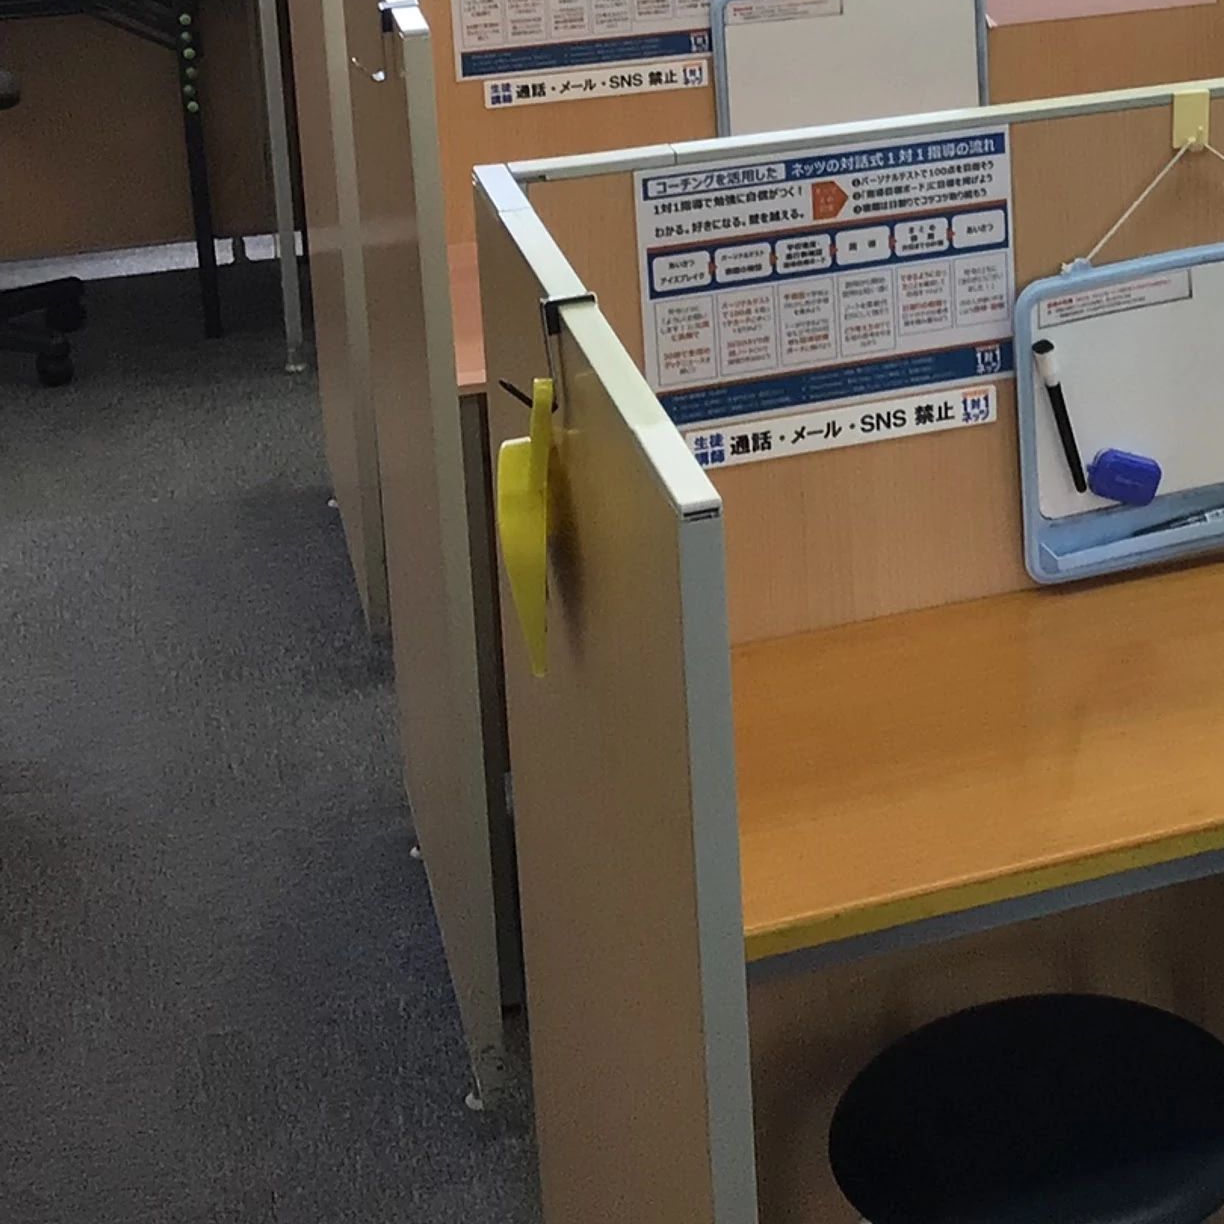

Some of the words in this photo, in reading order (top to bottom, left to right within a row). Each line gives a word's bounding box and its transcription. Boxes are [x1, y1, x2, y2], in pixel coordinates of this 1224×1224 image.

[655, 167, 778, 194] コーチングを活用した
[914, 400, 955, 425] 禁止
